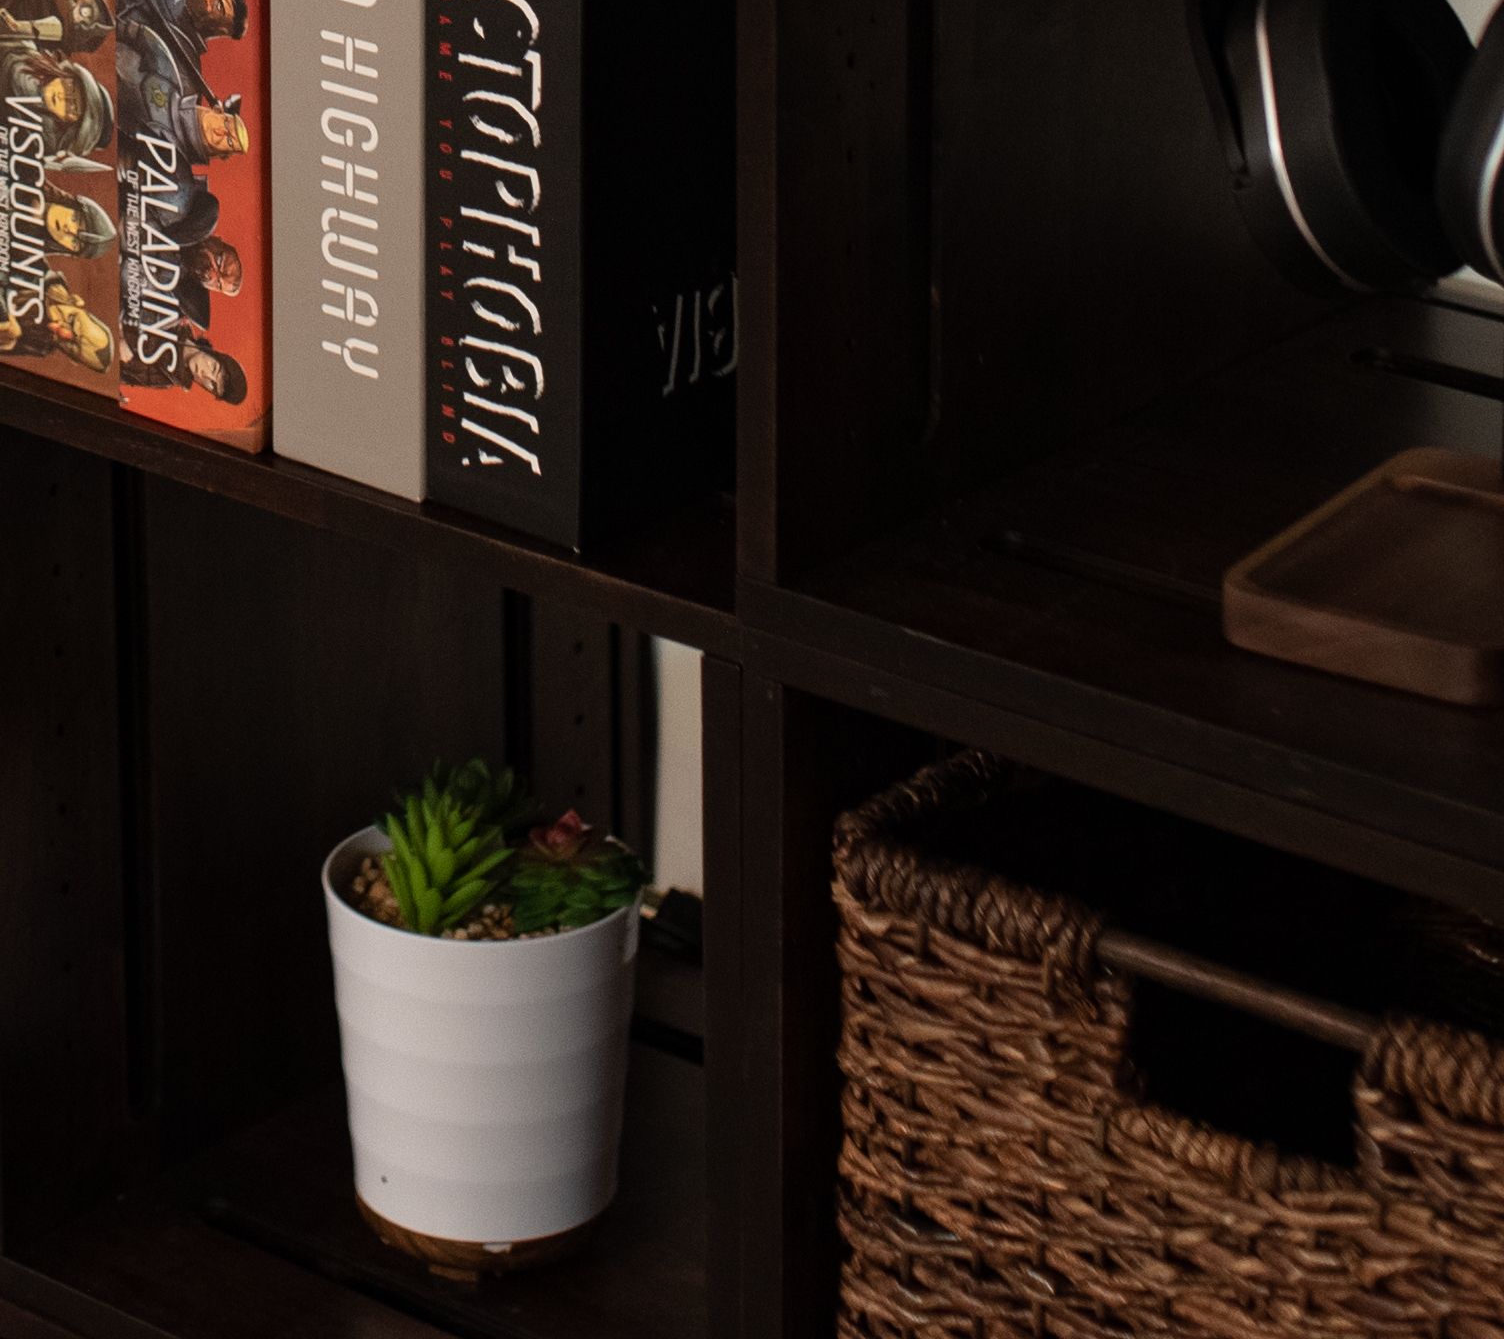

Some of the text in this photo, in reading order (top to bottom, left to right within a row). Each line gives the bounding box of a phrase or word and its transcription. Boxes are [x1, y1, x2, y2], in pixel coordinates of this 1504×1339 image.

[4, 95, 45, 324] VISCOUNTS
[320, 29, 379, 379] HIGHWAY
[439, 119, 454, 181] YOU
[126, 169, 140, 318] OF THE WEST KINGDOM
[135, 132, 179, 373] PALADINS
[439, 217, 454, 302] PLAY
[440, 336, 456, 444] BLIND
